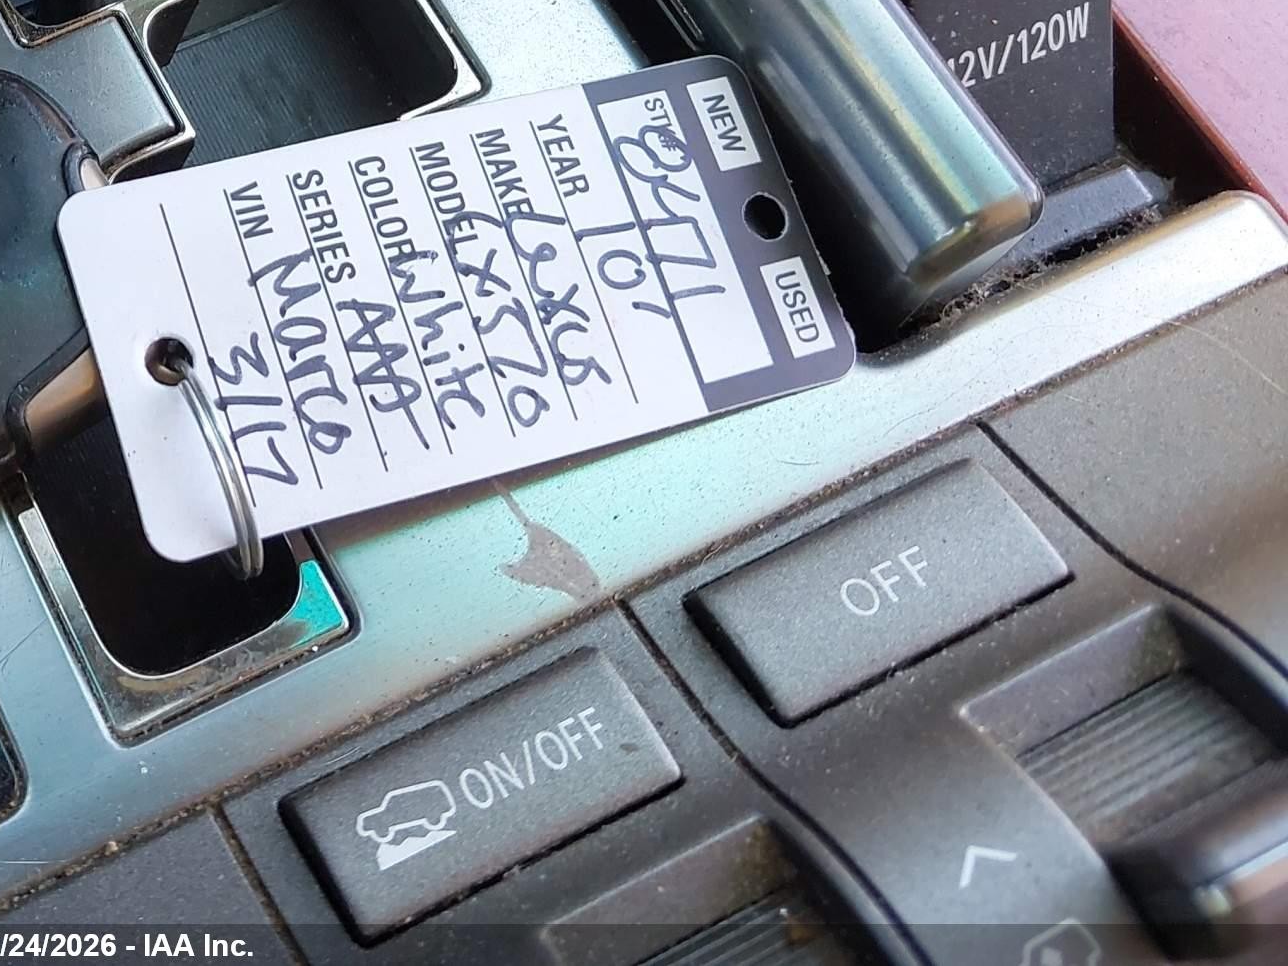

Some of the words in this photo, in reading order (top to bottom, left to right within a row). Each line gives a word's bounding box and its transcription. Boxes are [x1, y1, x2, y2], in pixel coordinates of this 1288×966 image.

[537, 113, 590, 197] YEAR
[702, 93, 746, 154] NEW
[230, 181, 274, 239] VIN
[354, 155, 416, 265] COLOR
[414, 141, 478, 256] MODEL
[475, 128, 535, 218] MAKE
[612, 124, 726, 301] 8471
[292, 169, 357, 284] SERIES
[247, 248, 353, 455] Marco
[775, 269, 820, 344] USED
[839, 545, 928, 616] OFF
[459, 706, 604, 810] ON/OFF
